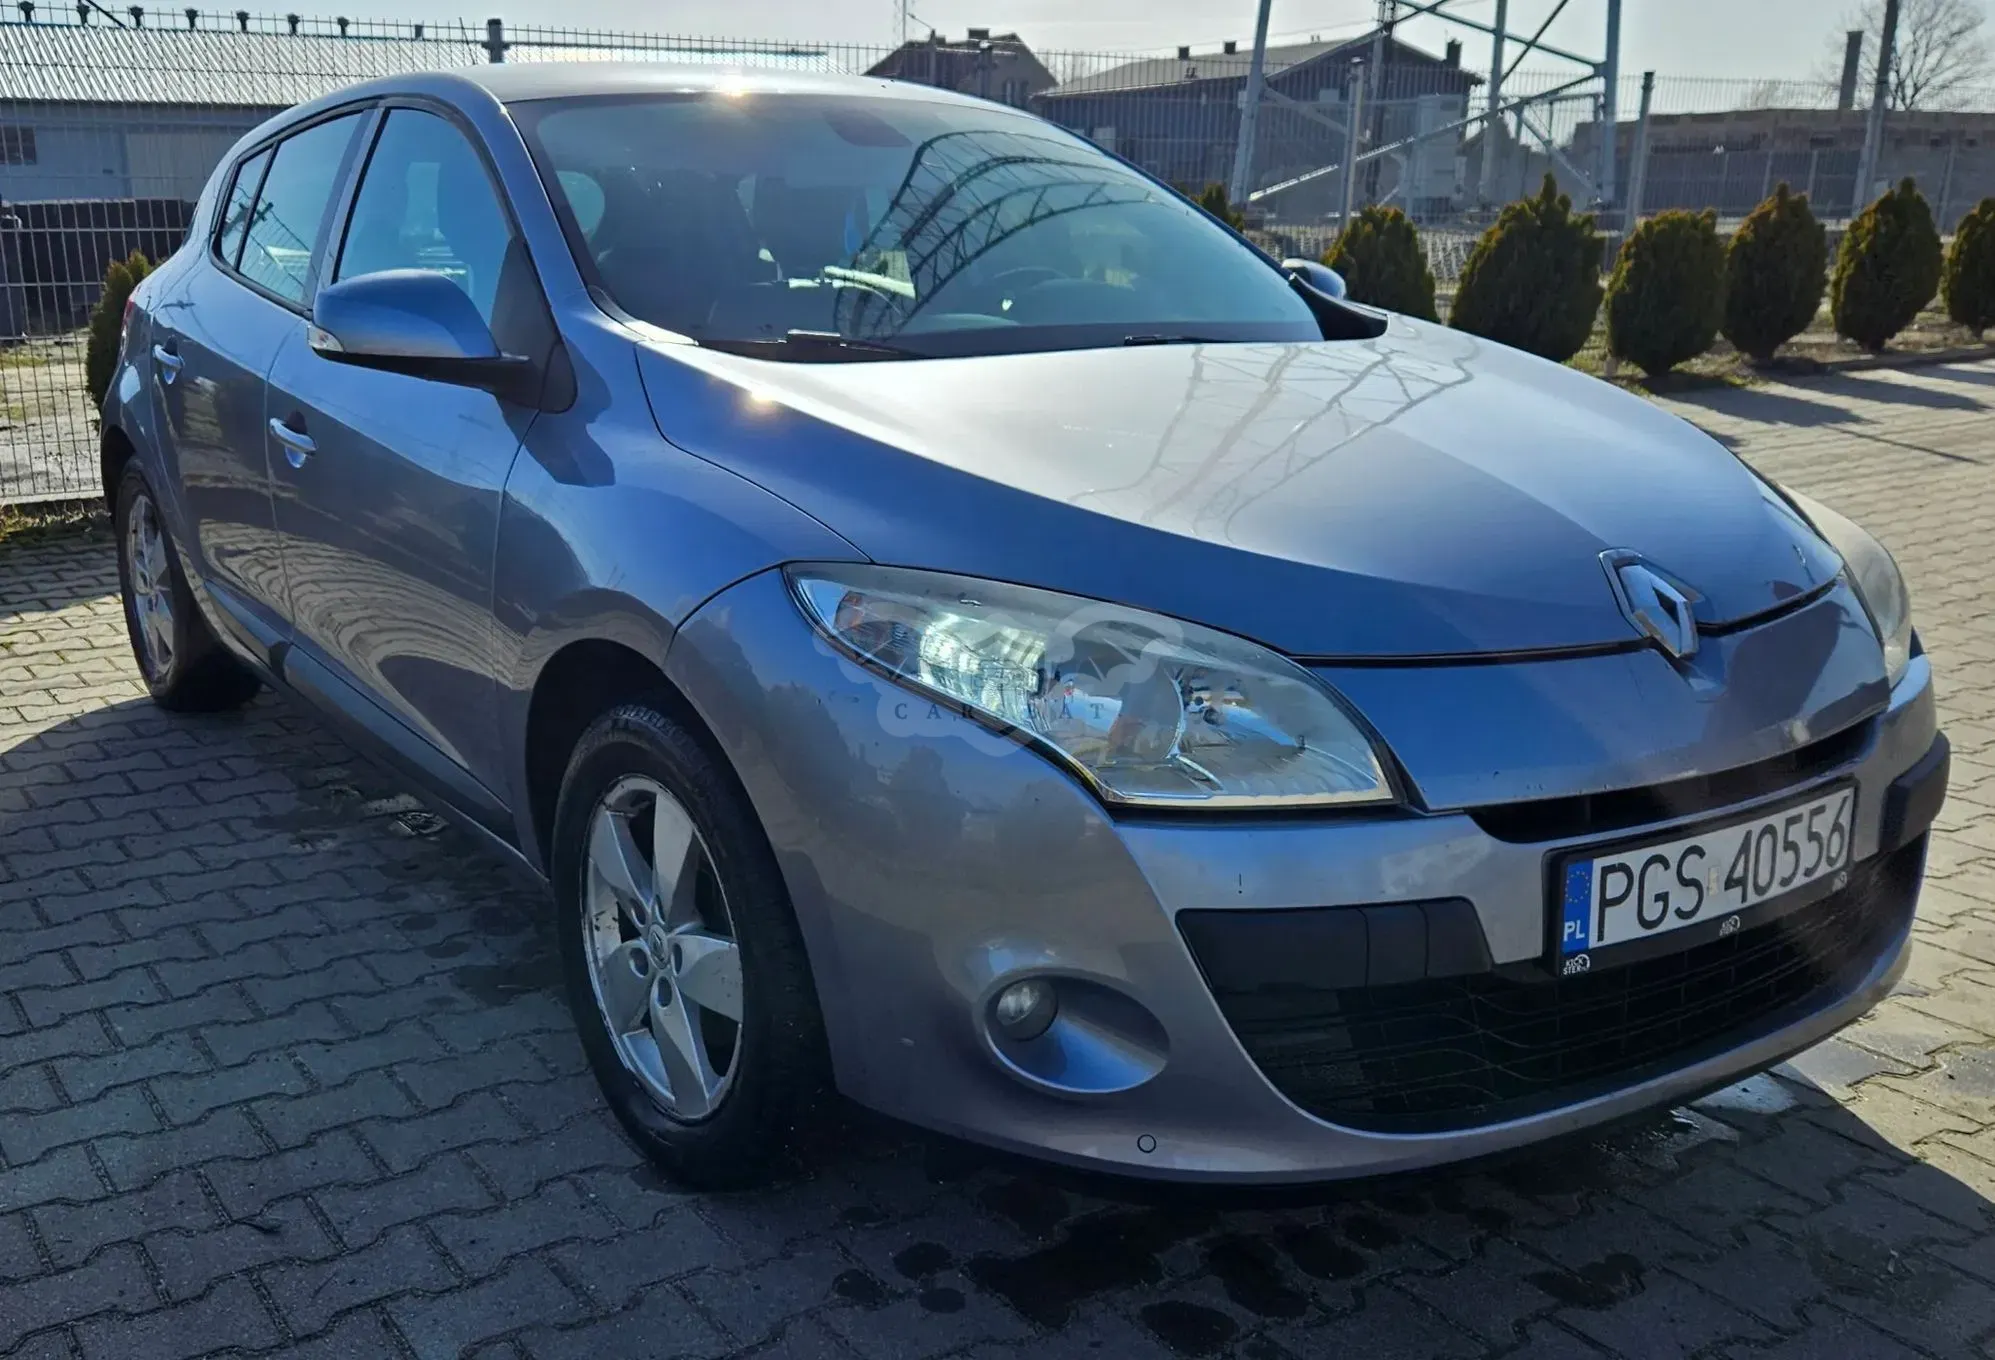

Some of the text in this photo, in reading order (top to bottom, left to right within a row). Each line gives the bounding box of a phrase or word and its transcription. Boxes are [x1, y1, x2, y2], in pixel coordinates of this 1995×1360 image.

[1596, 795, 1849, 942] PGS 40556
[1563, 920, 1585, 942] PL
